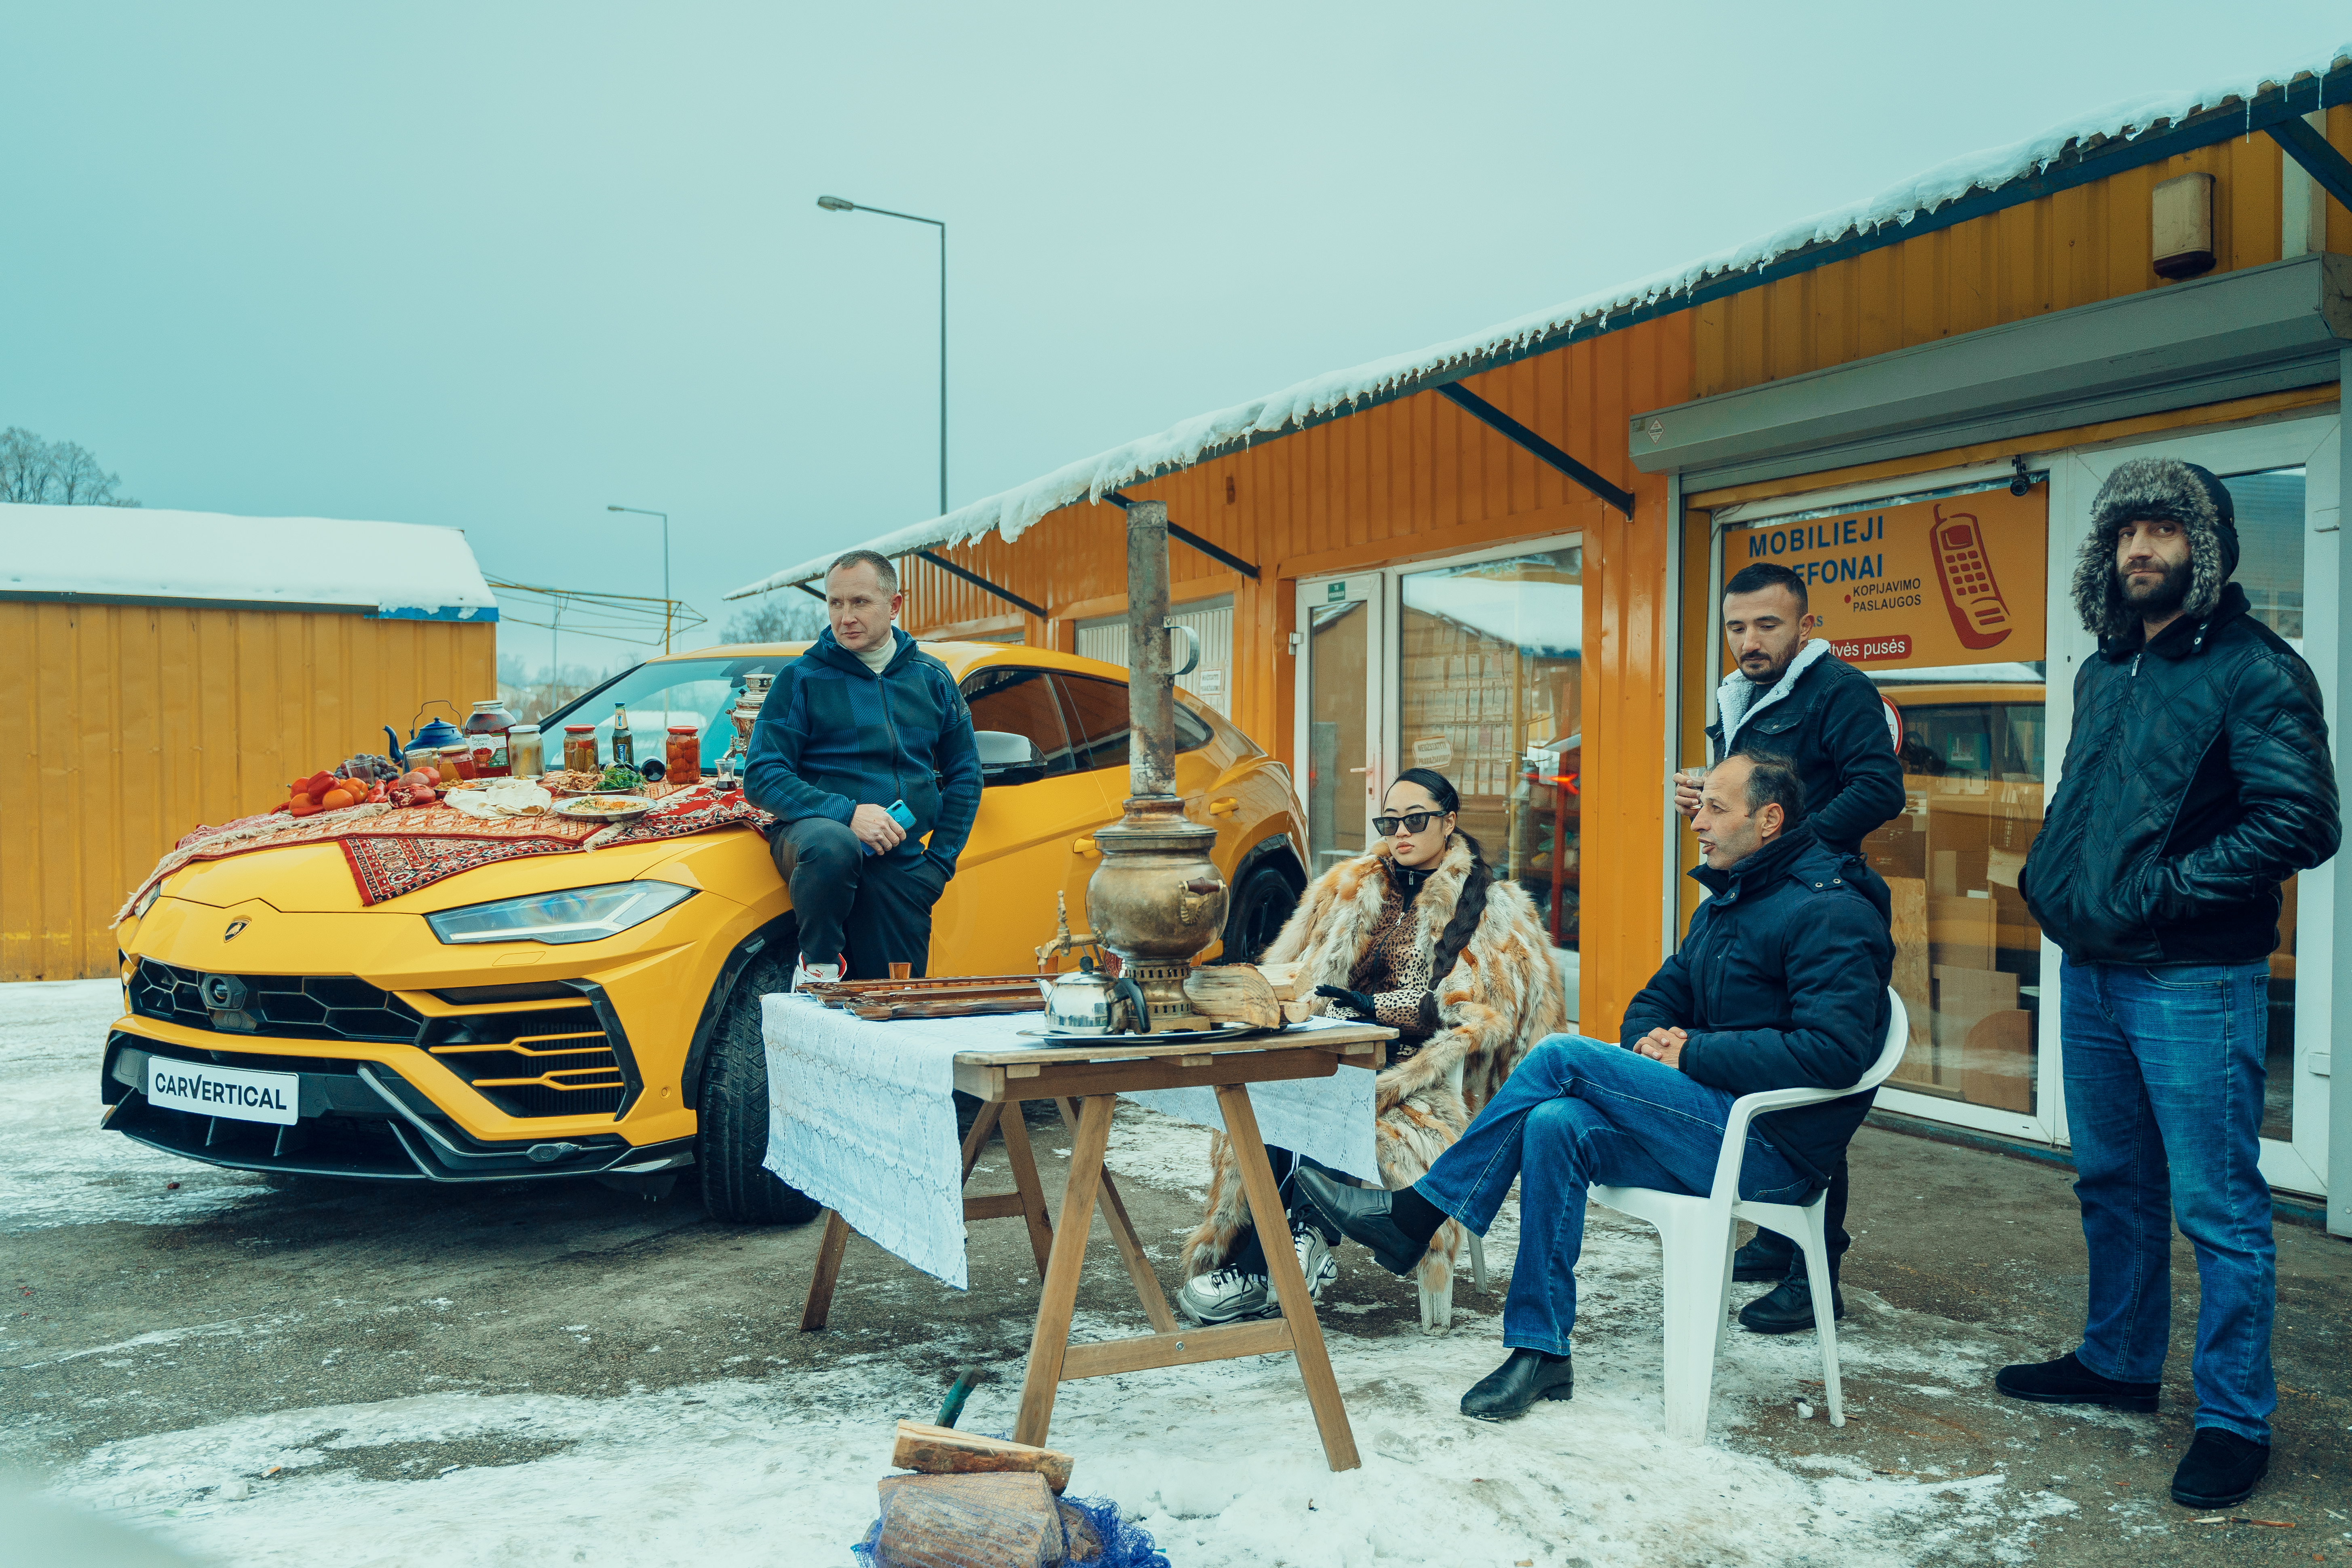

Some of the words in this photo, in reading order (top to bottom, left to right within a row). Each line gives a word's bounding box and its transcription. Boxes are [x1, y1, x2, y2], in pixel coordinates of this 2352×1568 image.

[1749, 515, 1883, 558] MOBILIEJI
[1793, 553, 1882, 585] FONAI
[1853, 578, 1921, 597] KOPIJAVIMO
[1853, 594, 1921, 613] PASLAUGOS
[1828, 642, 1859, 657] tvės
[1864, 638, 1905, 659] pusės
[155, 1073, 287, 1110] CARVERTICAL
